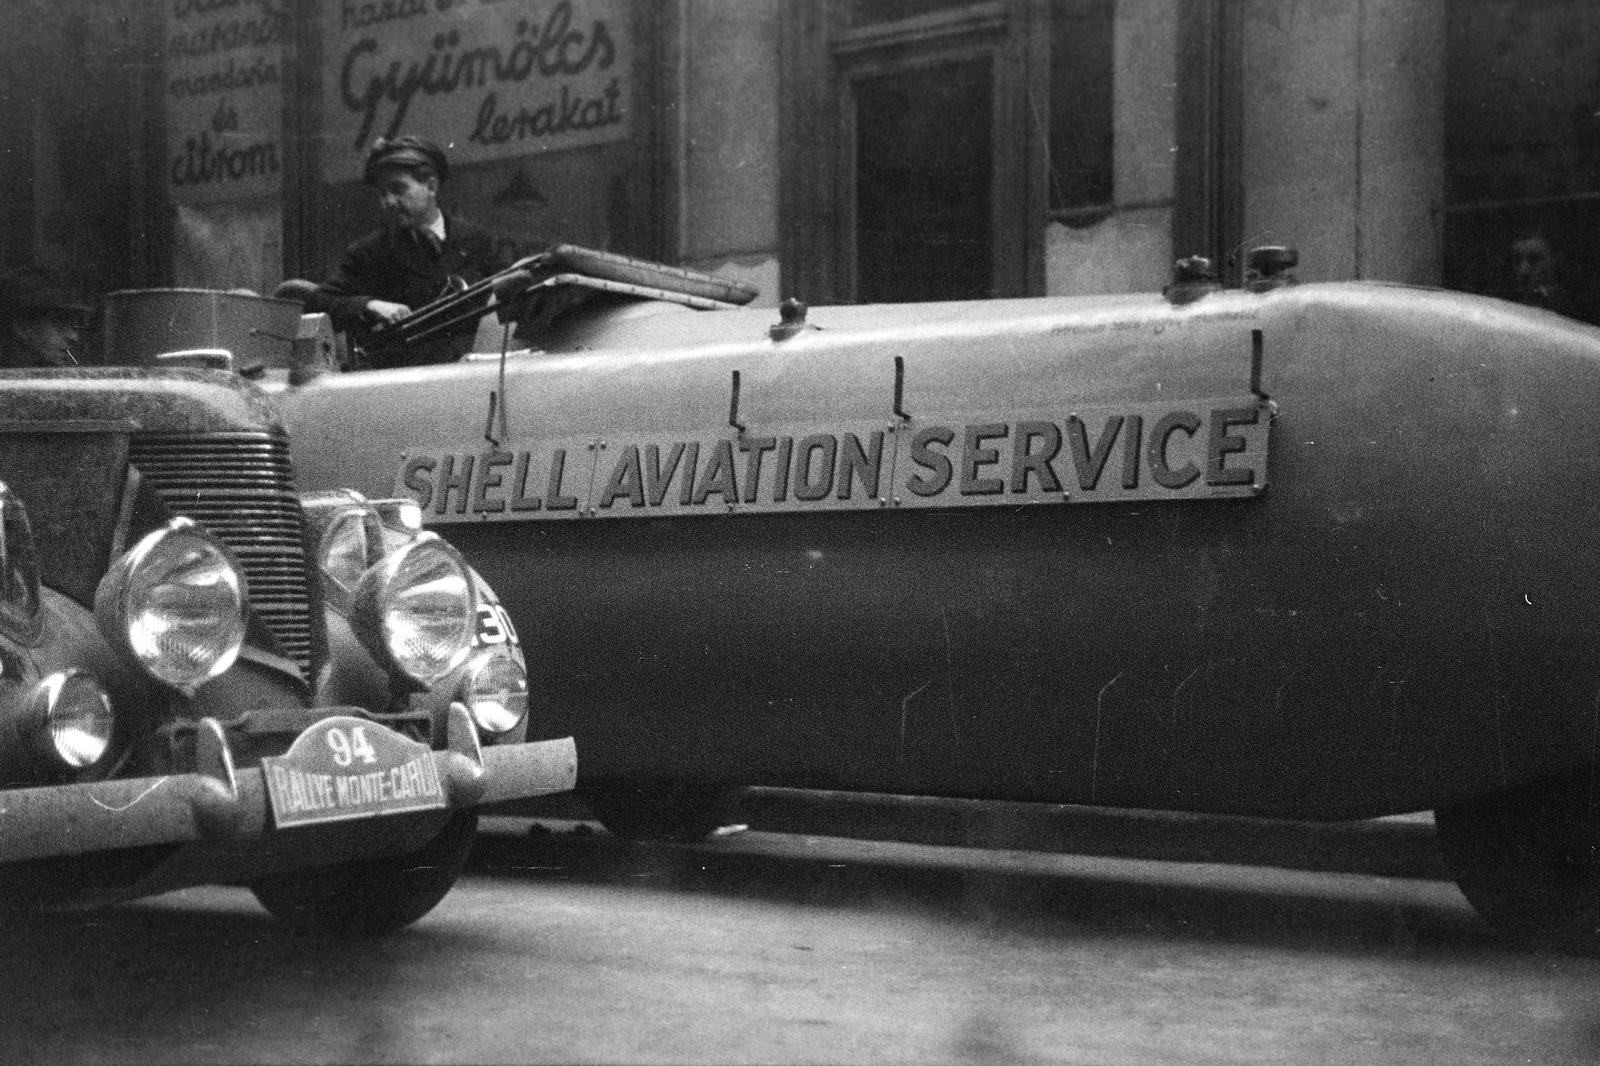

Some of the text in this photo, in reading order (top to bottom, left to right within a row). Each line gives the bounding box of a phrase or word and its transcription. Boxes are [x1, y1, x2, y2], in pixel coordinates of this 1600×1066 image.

[340, 1, 615, 150] Gyümölcs
[469, 77, 621, 145] lerakat
[171, 131, 281, 186] citrom
[404, 406, 1259, 515] SHELL AVIATION SERVICE
[327, 726, 377, 767] 94
[271, 764, 337, 813] RALLYE
